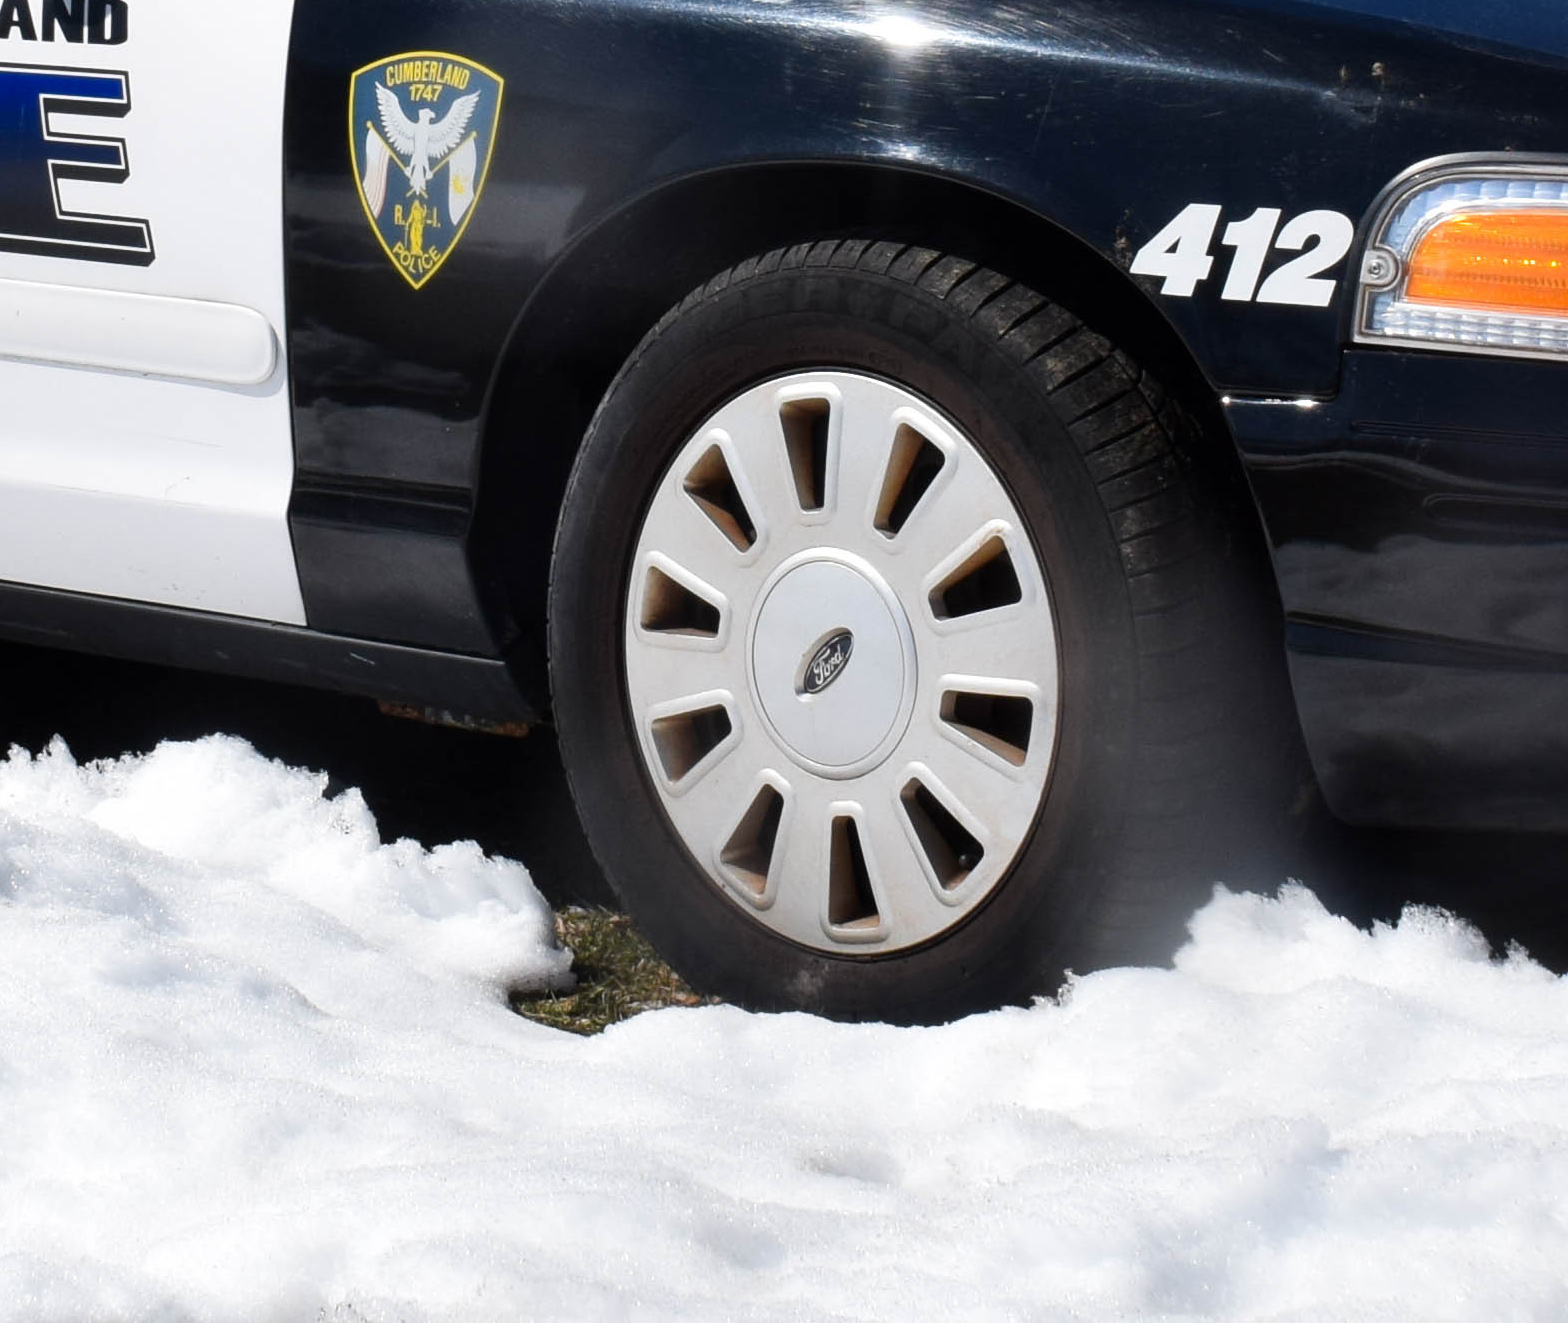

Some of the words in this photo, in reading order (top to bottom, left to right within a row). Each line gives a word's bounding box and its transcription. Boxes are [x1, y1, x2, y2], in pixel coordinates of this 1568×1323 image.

[385, 60, 471, 91] CUMBERLAND
[409, 83, 443, 102] 1747
[391, 241, 443, 274] POLICE
[1129, 202, 1356, 308] 412
[812, 643, 845, 686] Ford
